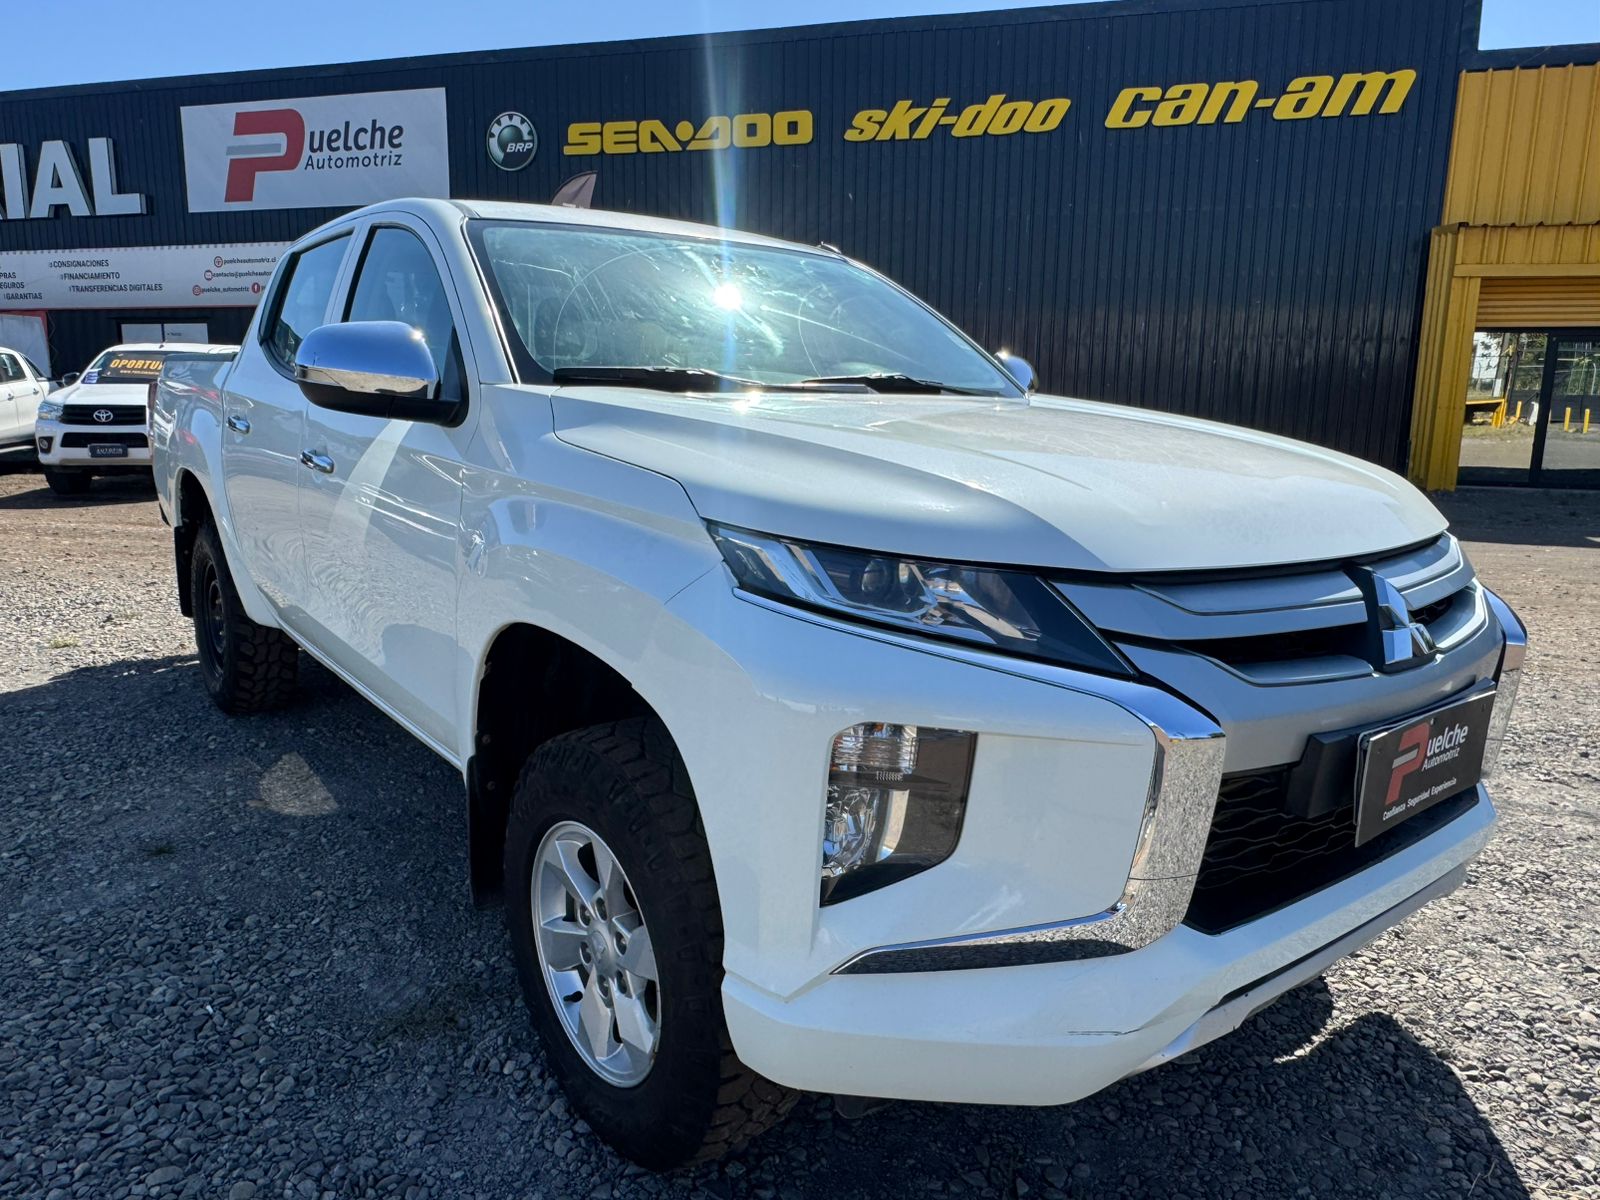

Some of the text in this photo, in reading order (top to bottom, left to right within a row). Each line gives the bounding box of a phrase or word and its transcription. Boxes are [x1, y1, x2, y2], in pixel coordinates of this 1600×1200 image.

[1105, 69, 1416, 128] can-am
[844, 94, 1071, 141] ski-doo
[506, 142, 533, 152] BRP
[304, 151, 402, 170] Automotriz
[0, 137, 147, 220] IAL
[53, 259, 109, 268] CONSIGNACIONES
[64, 271, 120, 280] FINANCIAMIENTO
[71, 283, 163, 293] TRANSFERENCIAS DIGITALES
[1421, 747, 1460, 772] Automotriz
